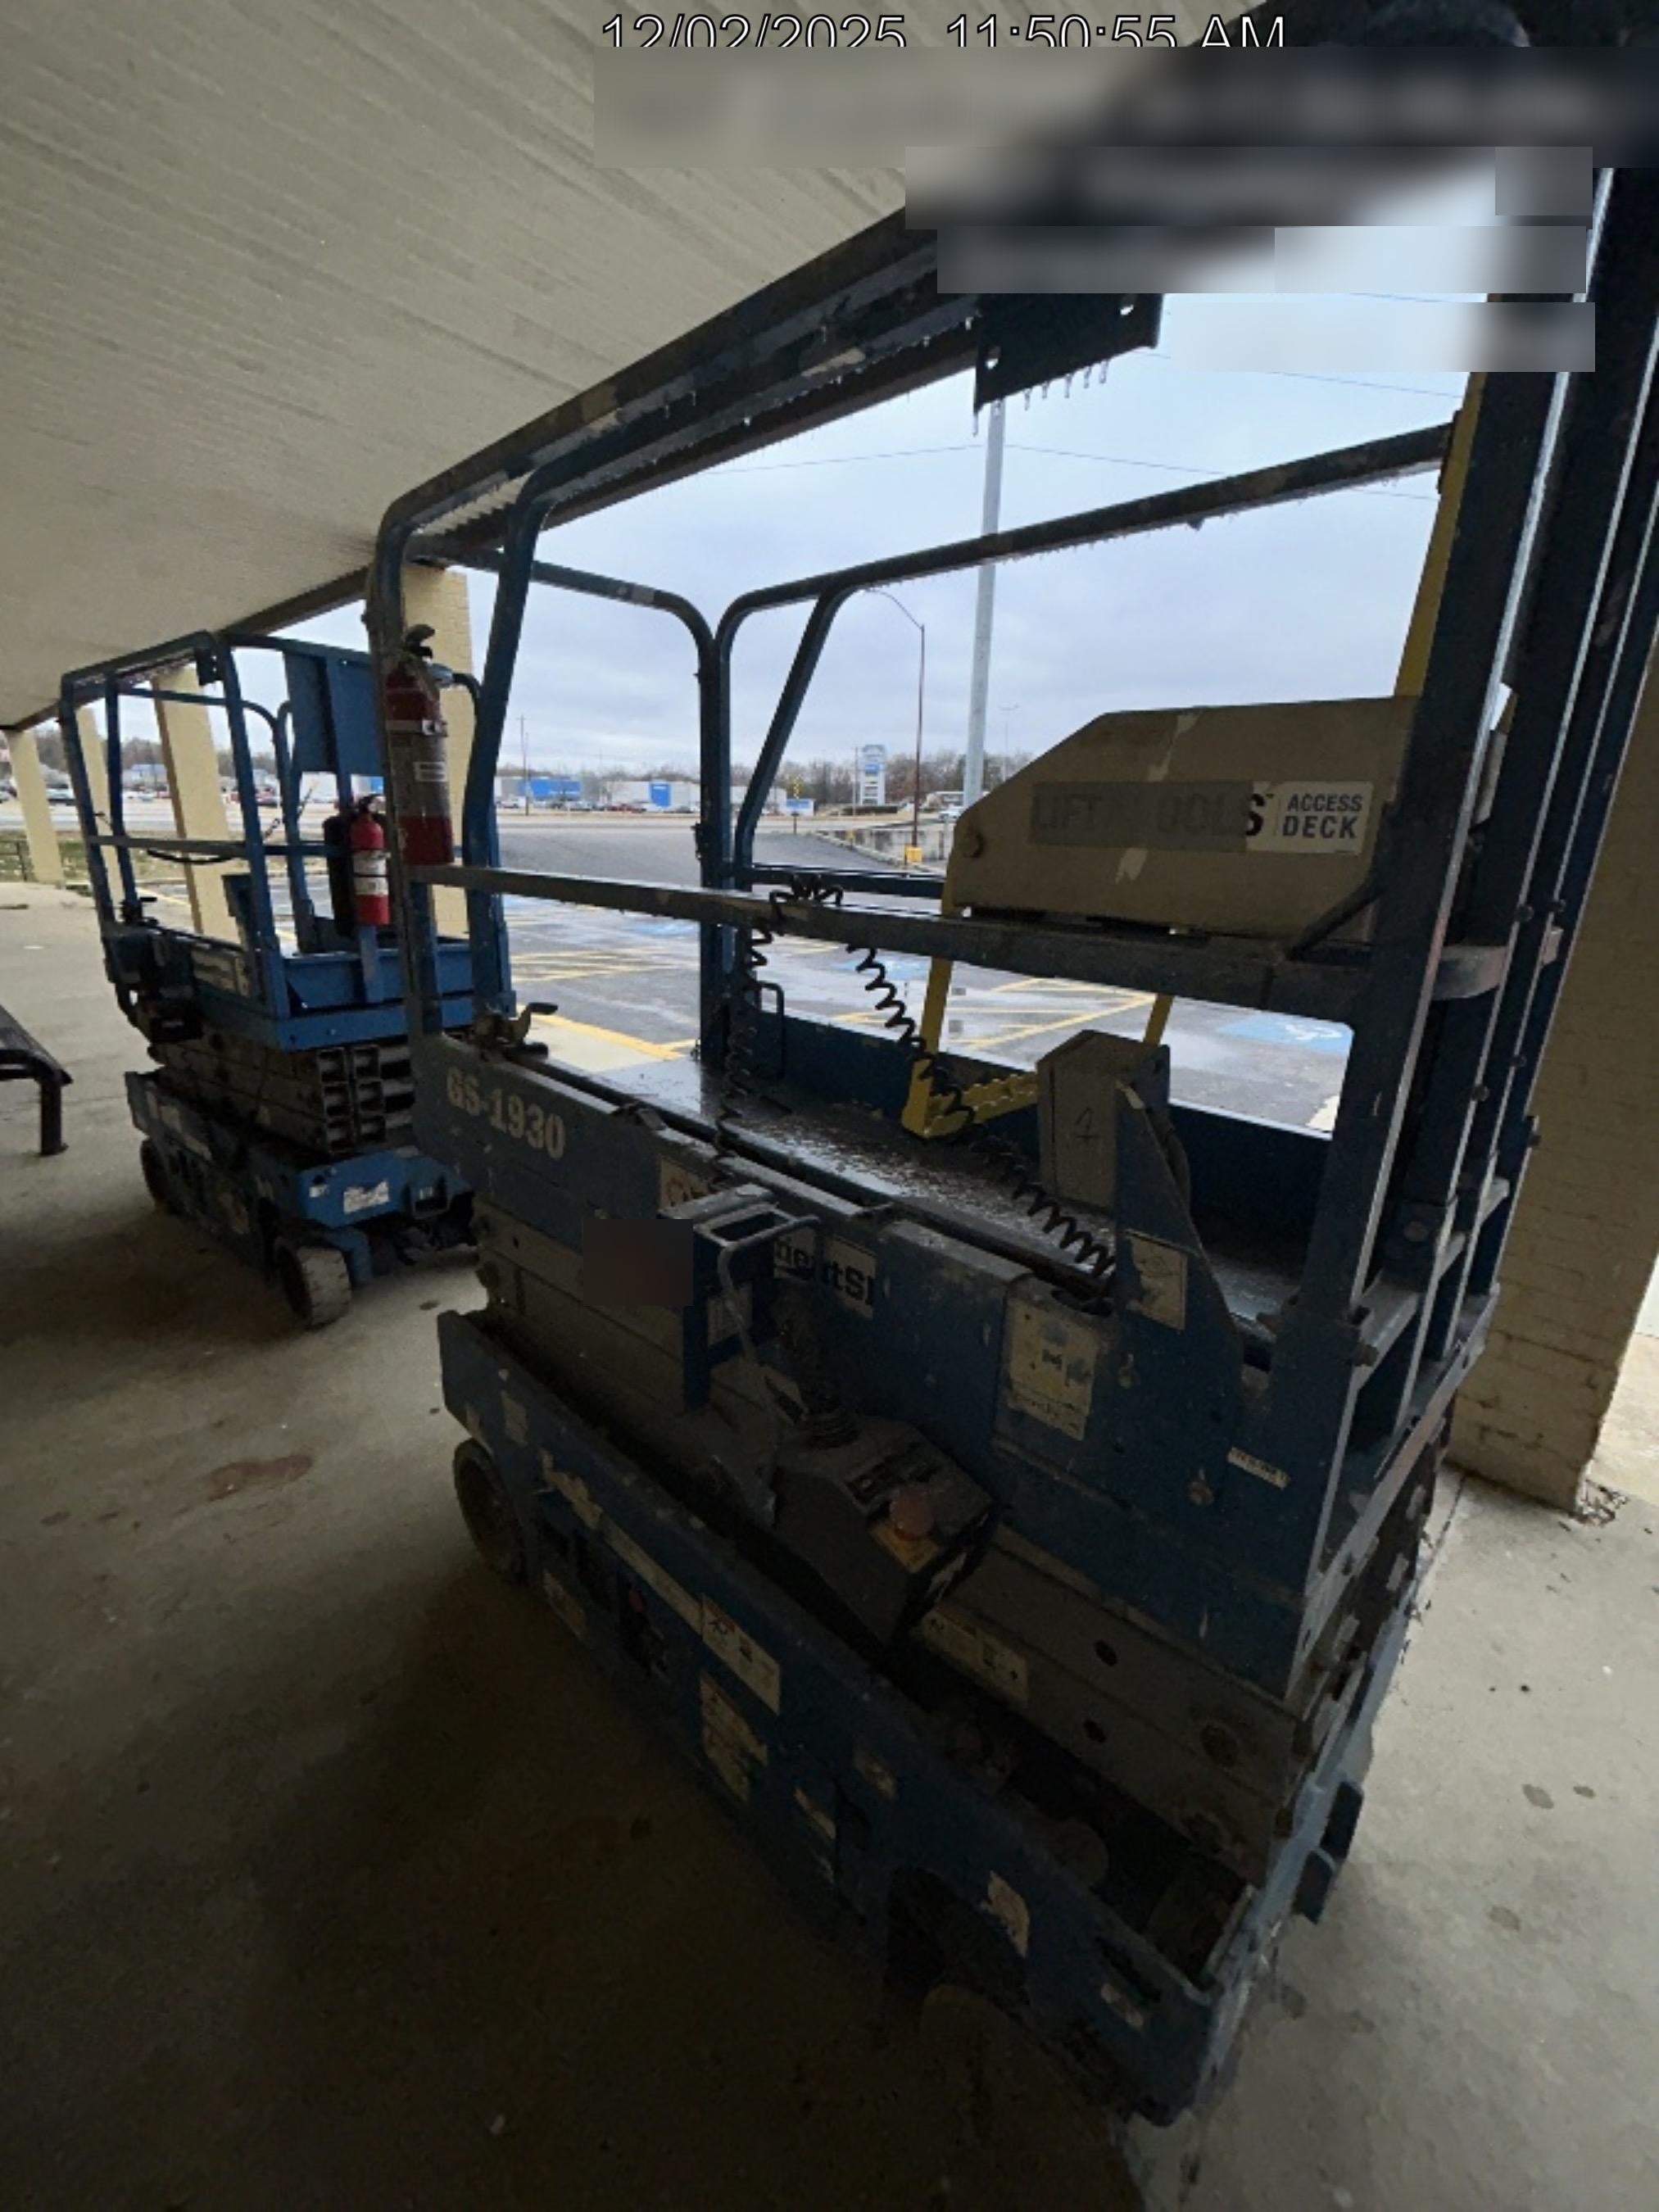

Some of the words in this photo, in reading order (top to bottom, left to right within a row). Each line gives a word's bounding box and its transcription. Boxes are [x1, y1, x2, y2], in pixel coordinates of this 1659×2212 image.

[1287, 793, 1363, 813] ACCESS
[1282, 815, 1358, 839] DECK
[446, 1066, 566, 1160] GS-1930
